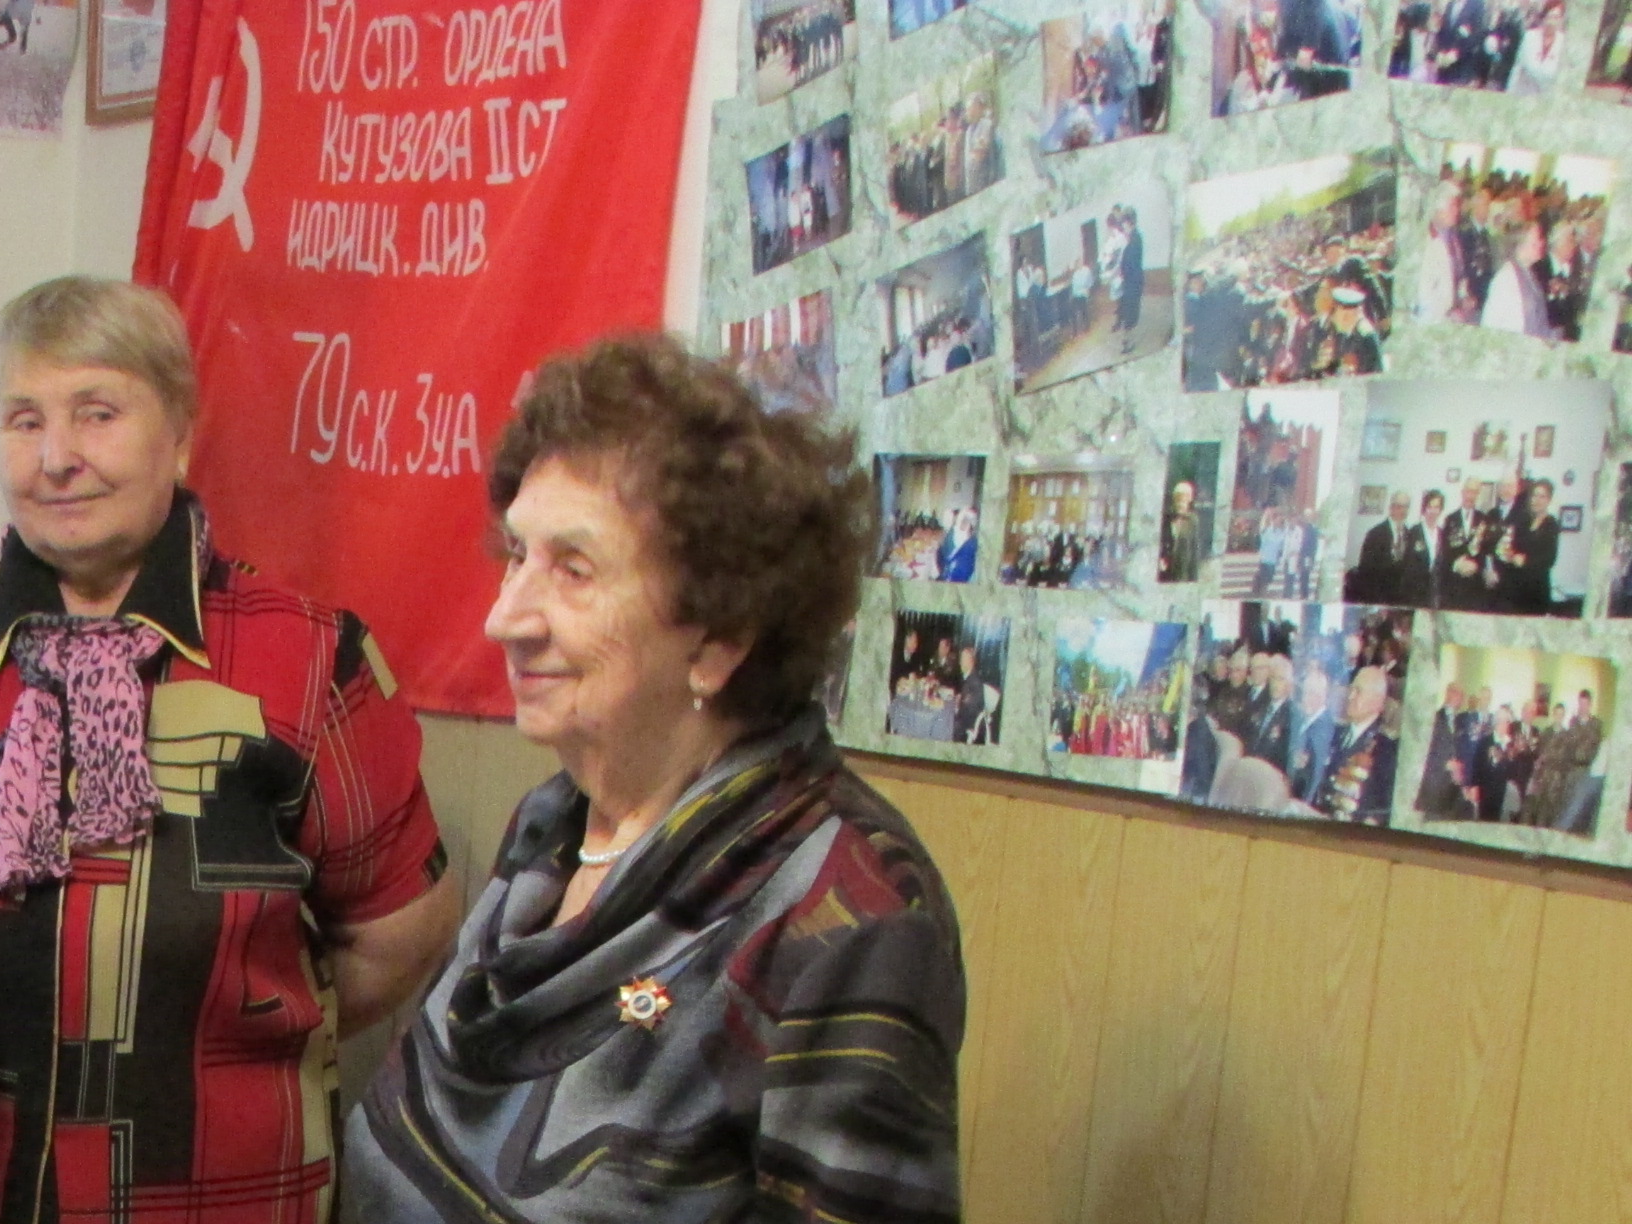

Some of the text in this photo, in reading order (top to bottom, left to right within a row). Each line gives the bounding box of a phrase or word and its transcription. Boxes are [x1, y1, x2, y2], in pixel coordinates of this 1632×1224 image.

[297, 0, 567, 94] 150 СТР. ОРДЕНА
[318, 100, 473, 185] КУТУЗОВА
[291, 331, 351, 465] 79
